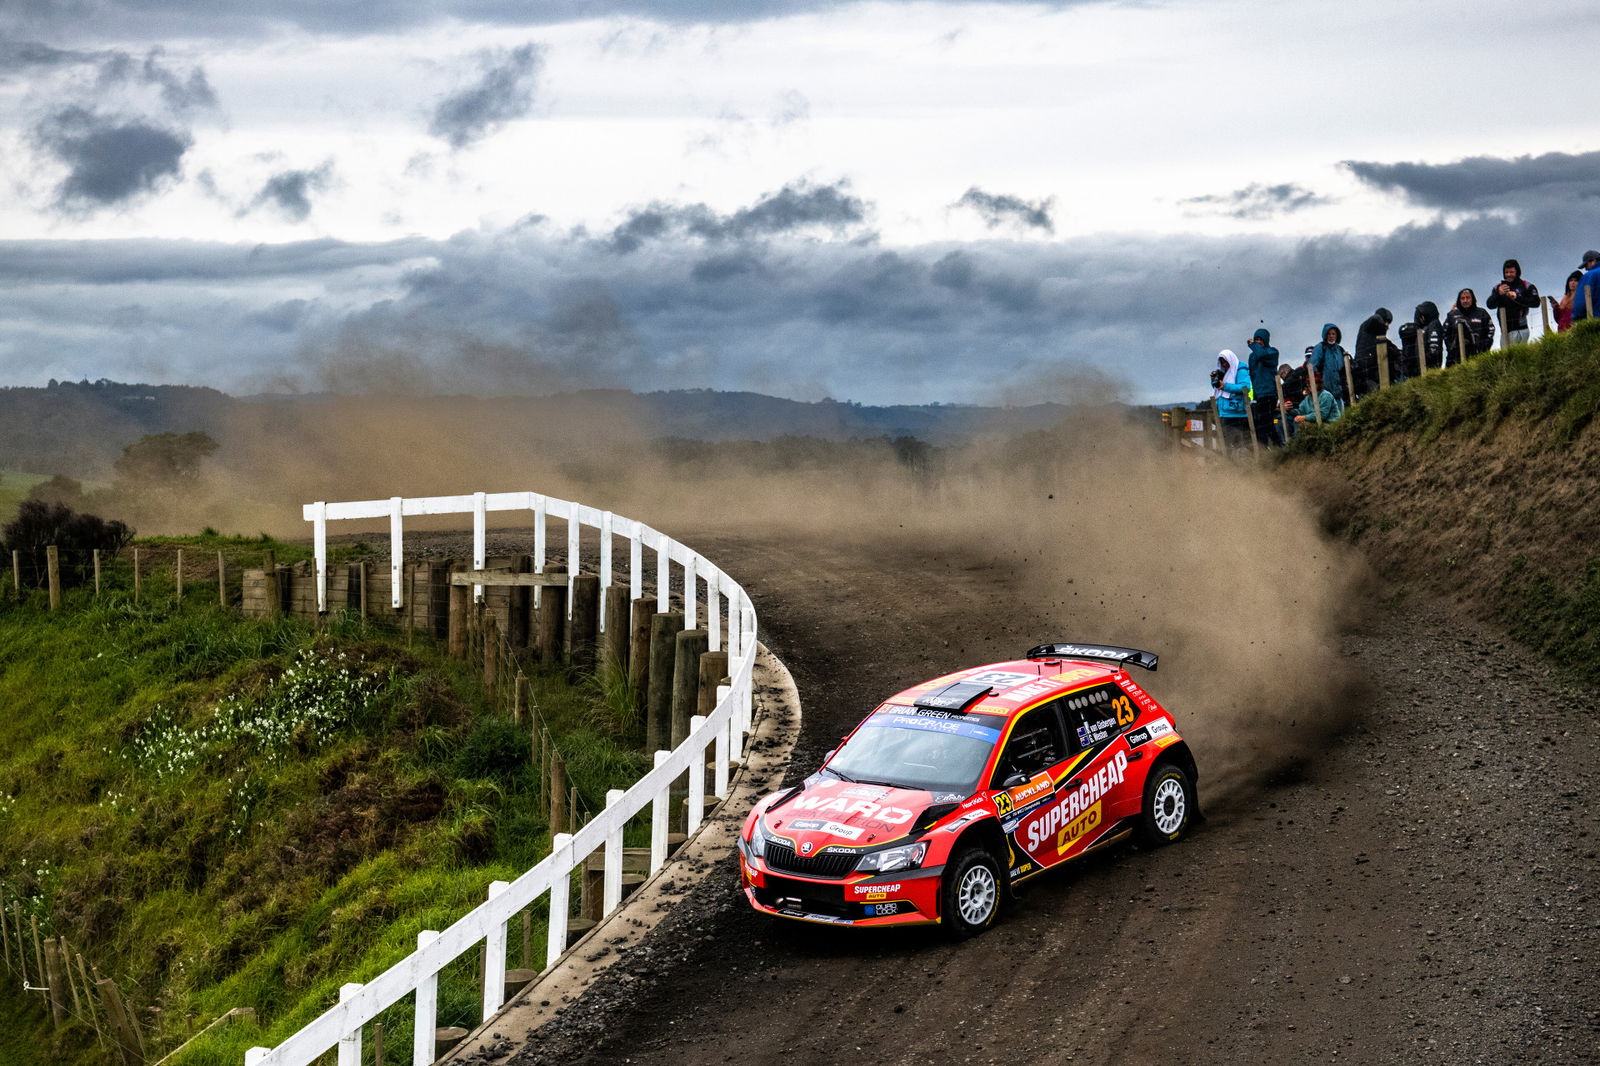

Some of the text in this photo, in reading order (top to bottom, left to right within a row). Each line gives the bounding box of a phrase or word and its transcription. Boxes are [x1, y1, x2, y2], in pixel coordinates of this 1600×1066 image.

[1060, 645, 1128, 659] ŠKODA
[888, 706, 918, 716] BRIAN
[917, 708, 951, 720] GREEN
[1112, 695, 1135, 726] 23
[1151, 723, 1168, 734] Group
[1014, 780, 1050, 803] AUCKLAND
[995, 793, 1013, 815] 23
[1027, 749, 1128, 853] SUPERCHEAP
[793, 796, 914, 825] WARD
[829, 825, 854, 836] Group
[1062, 810, 1098, 846] AUTO
[771, 836, 791, 847] ŠKODA
[827, 846, 857, 854] ŠKODA
[854, 884, 901, 894] SUPERCHEAP
